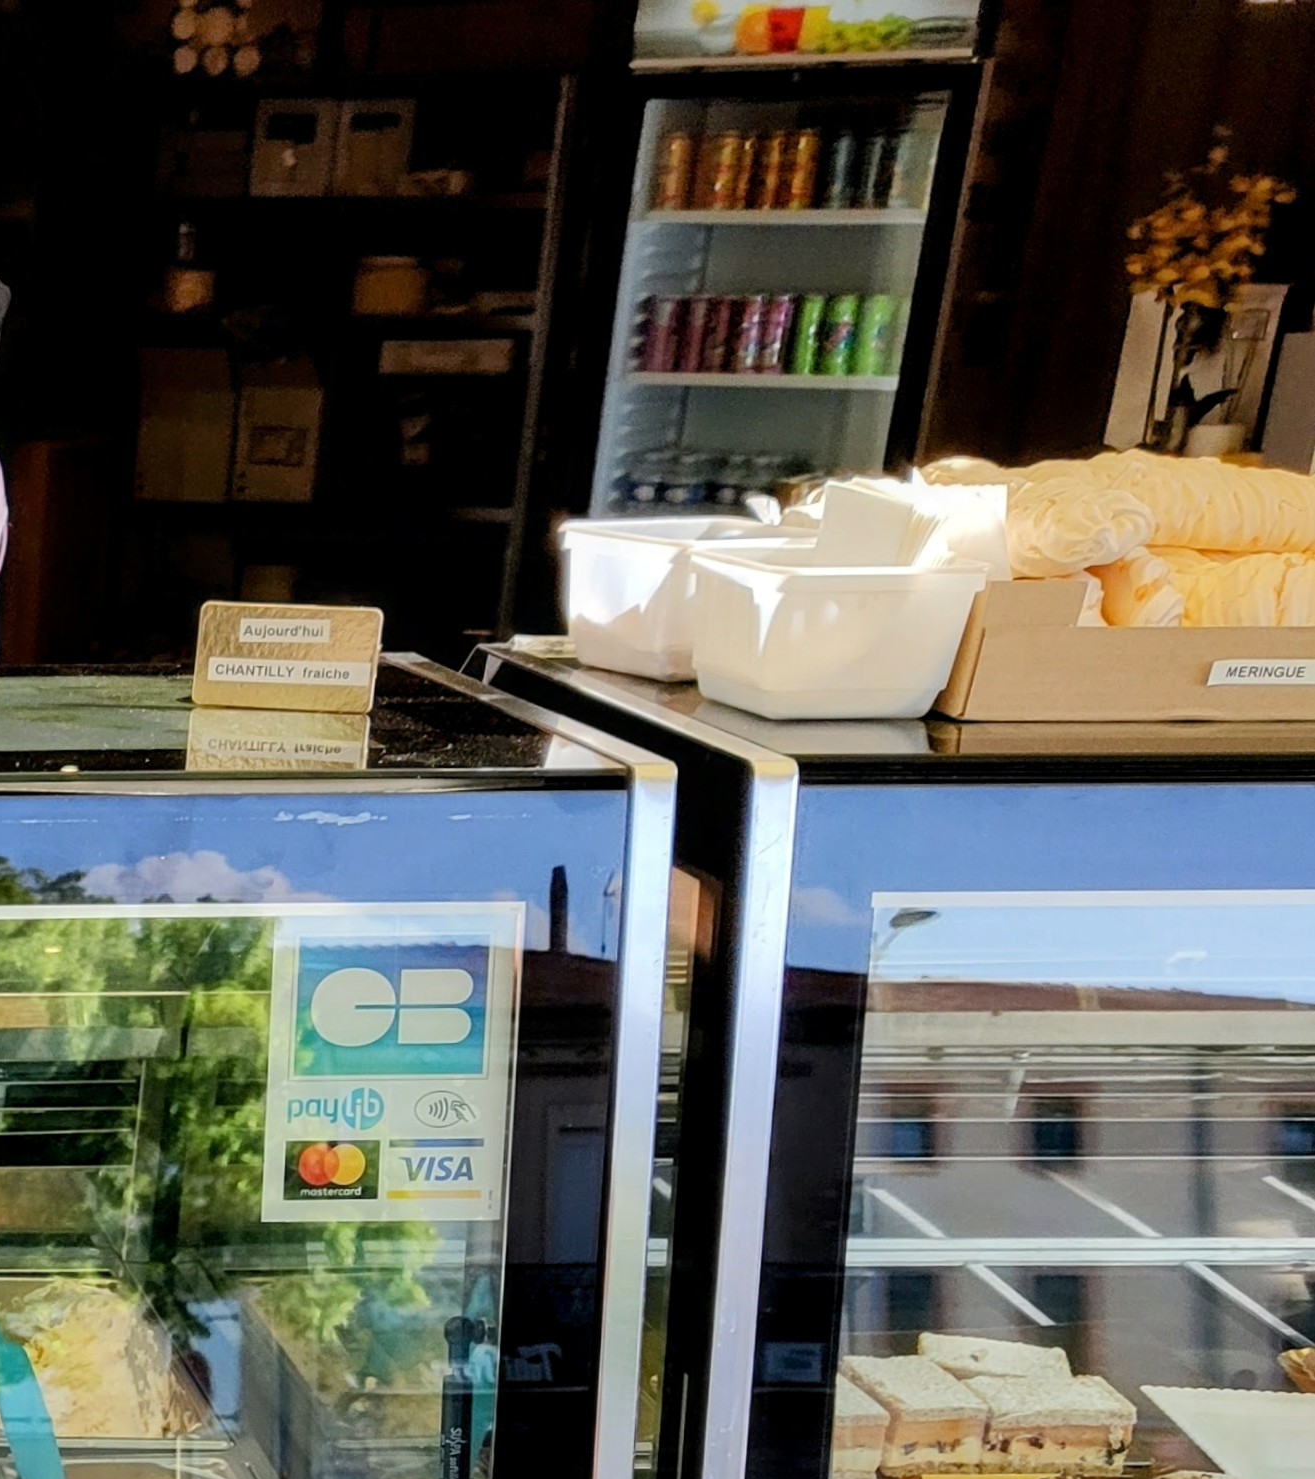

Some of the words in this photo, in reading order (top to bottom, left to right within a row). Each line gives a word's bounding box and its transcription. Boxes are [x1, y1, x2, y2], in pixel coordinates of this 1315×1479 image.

[242, 624, 324, 639] Aujourd'hui
[215, 663, 296, 678] CHANTILLY
[302, 667, 350, 680] fraiche
[1225, 665, 1307, 679] MERINGUE
[311, 967, 474, 1048] CB
[398, 1155, 474, 1182] VISA
[300, 1186, 362, 1197] mastercard
